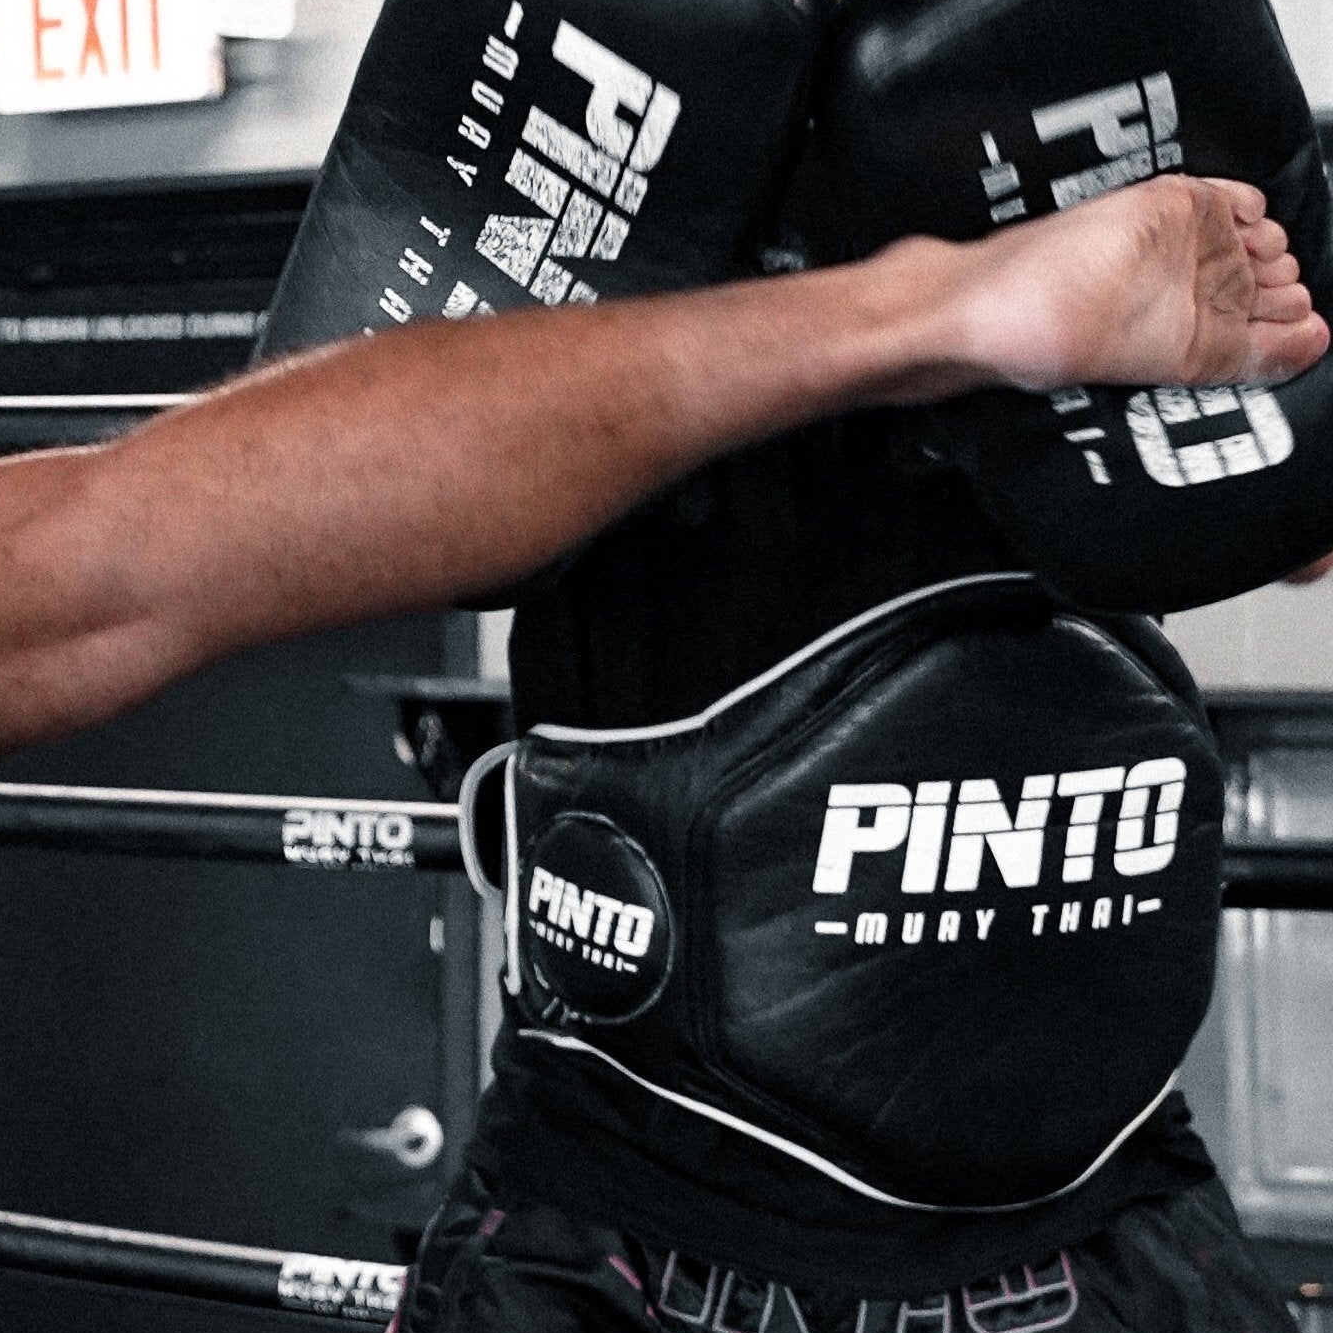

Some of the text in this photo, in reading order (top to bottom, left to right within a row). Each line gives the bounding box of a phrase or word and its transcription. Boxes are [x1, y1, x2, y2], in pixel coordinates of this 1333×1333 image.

[440, 18, 681, 319] PIN
[281, 809, 415, 851] PINTO
[812, 756, 1187, 894] PINTO
[528, 865, 655, 958] PINTO
